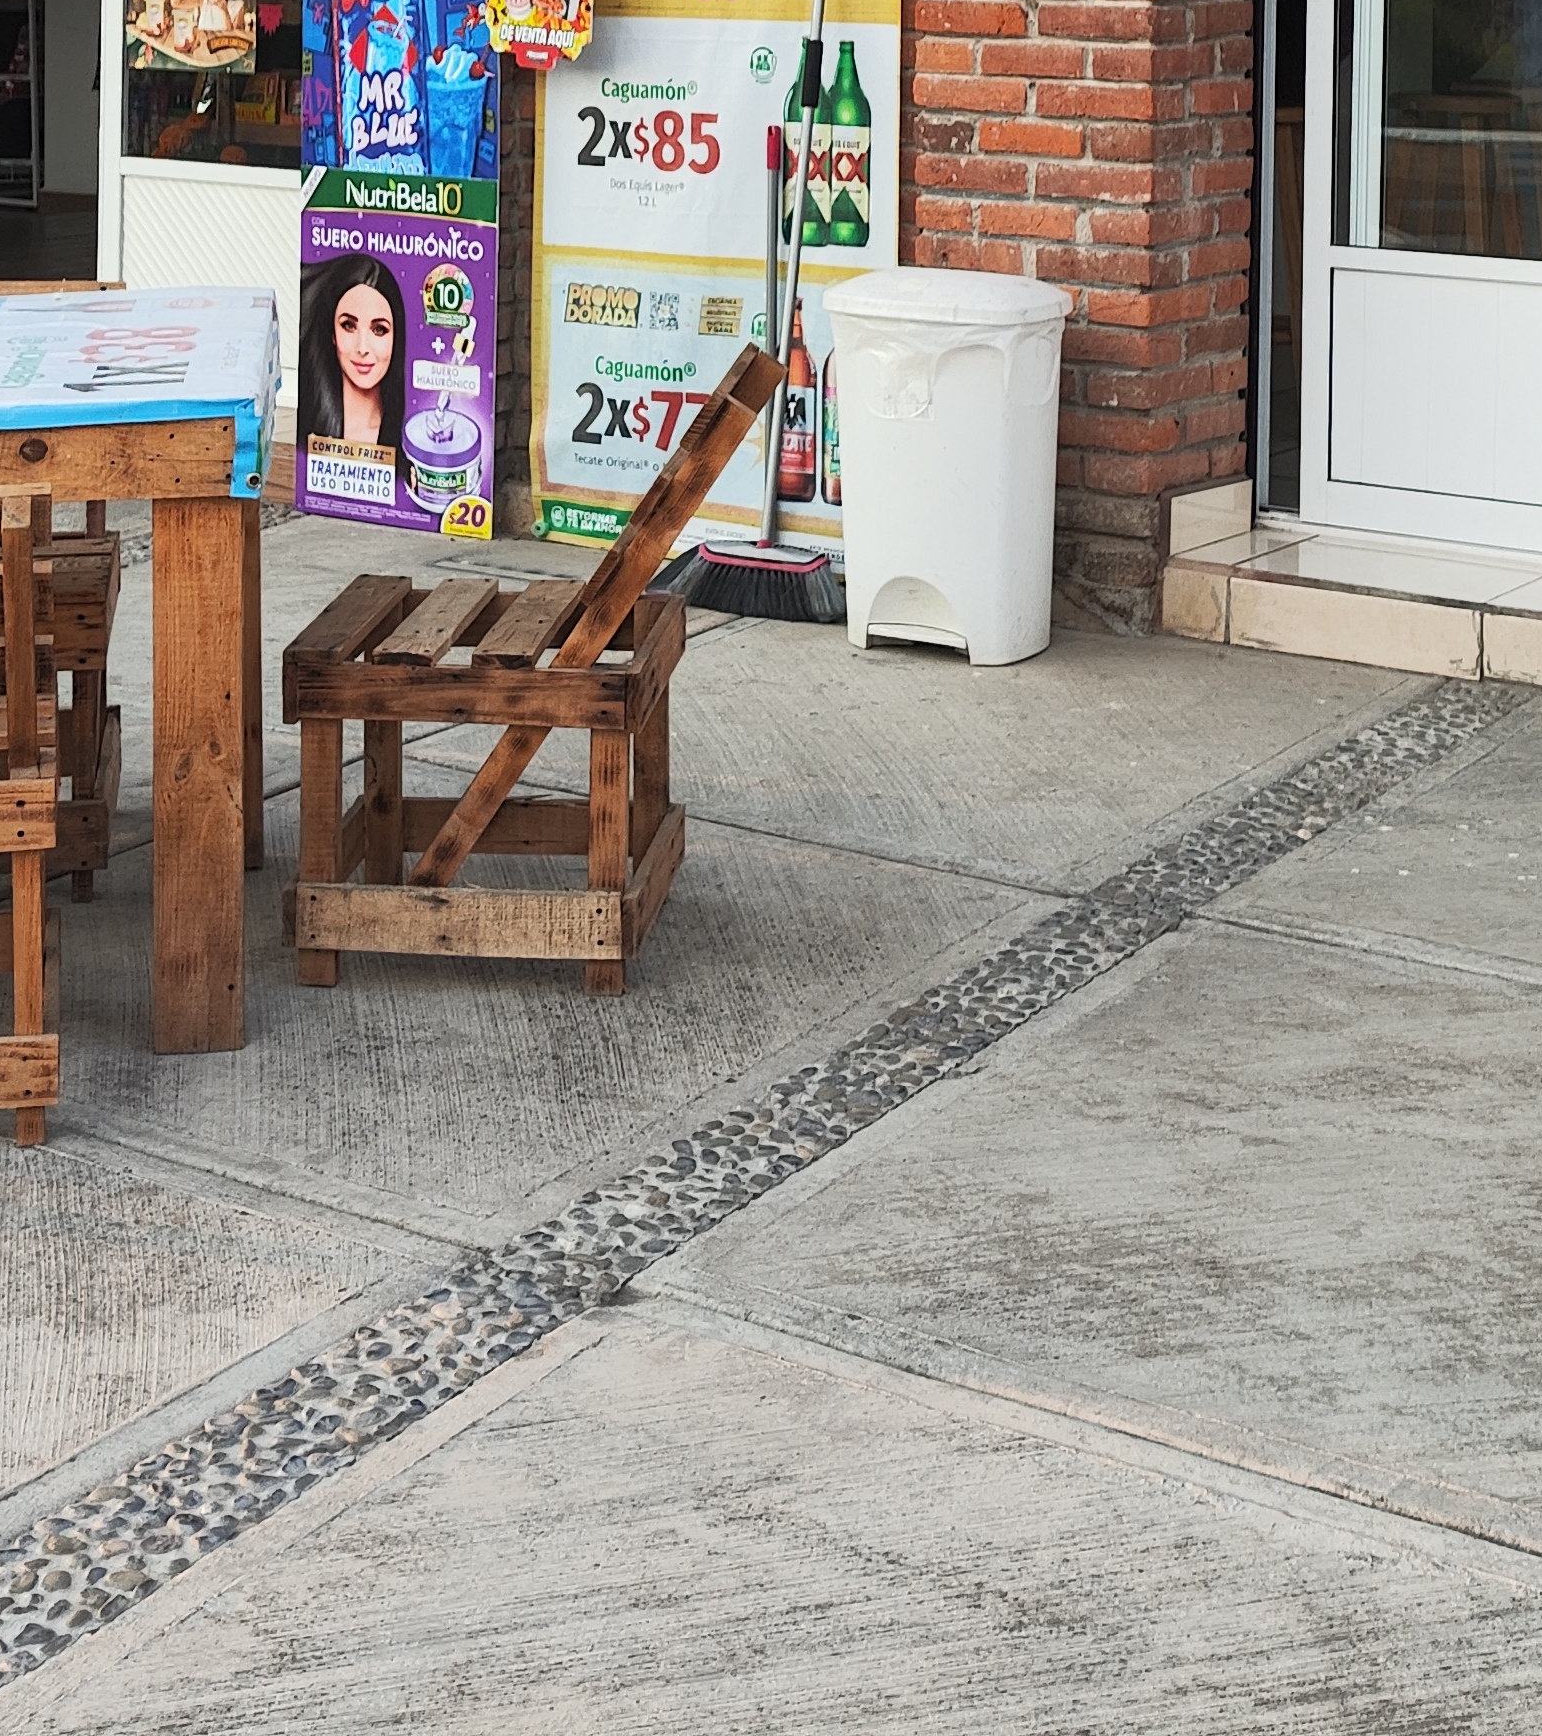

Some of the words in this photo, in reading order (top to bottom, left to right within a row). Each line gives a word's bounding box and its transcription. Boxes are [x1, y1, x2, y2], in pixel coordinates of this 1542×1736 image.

[500, 22, 515, 41] DE
[515, 24, 547, 45] VENTA
[359, 70, 404, 113] MR
[351, 108, 418, 152] BLUE
[577, 106, 721, 175] 2x$85
[345, 178, 463, 215] NutriBela10
[610, 178, 627, 190] Dos
[311, 216, 326, 227] CON
[311, 226, 364, 251] SUERO
[367, 227, 485, 262] HIALURÓNICO
[437, 283, 460, 311] 10
[566, 282, 641, 309] PROMO
[564, 303, 638, 328] DORADA
[431, 365, 460, 378] SUERO
[312, 440, 355, 457] CONTROL
[574, 452, 603, 466] Tecate
[311, 459, 392, 484] TRATAMIENTO
[311, 477, 336, 490] USO
[343, 480, 390, 498] DIARIO
[448, 502, 486, 529] $20
